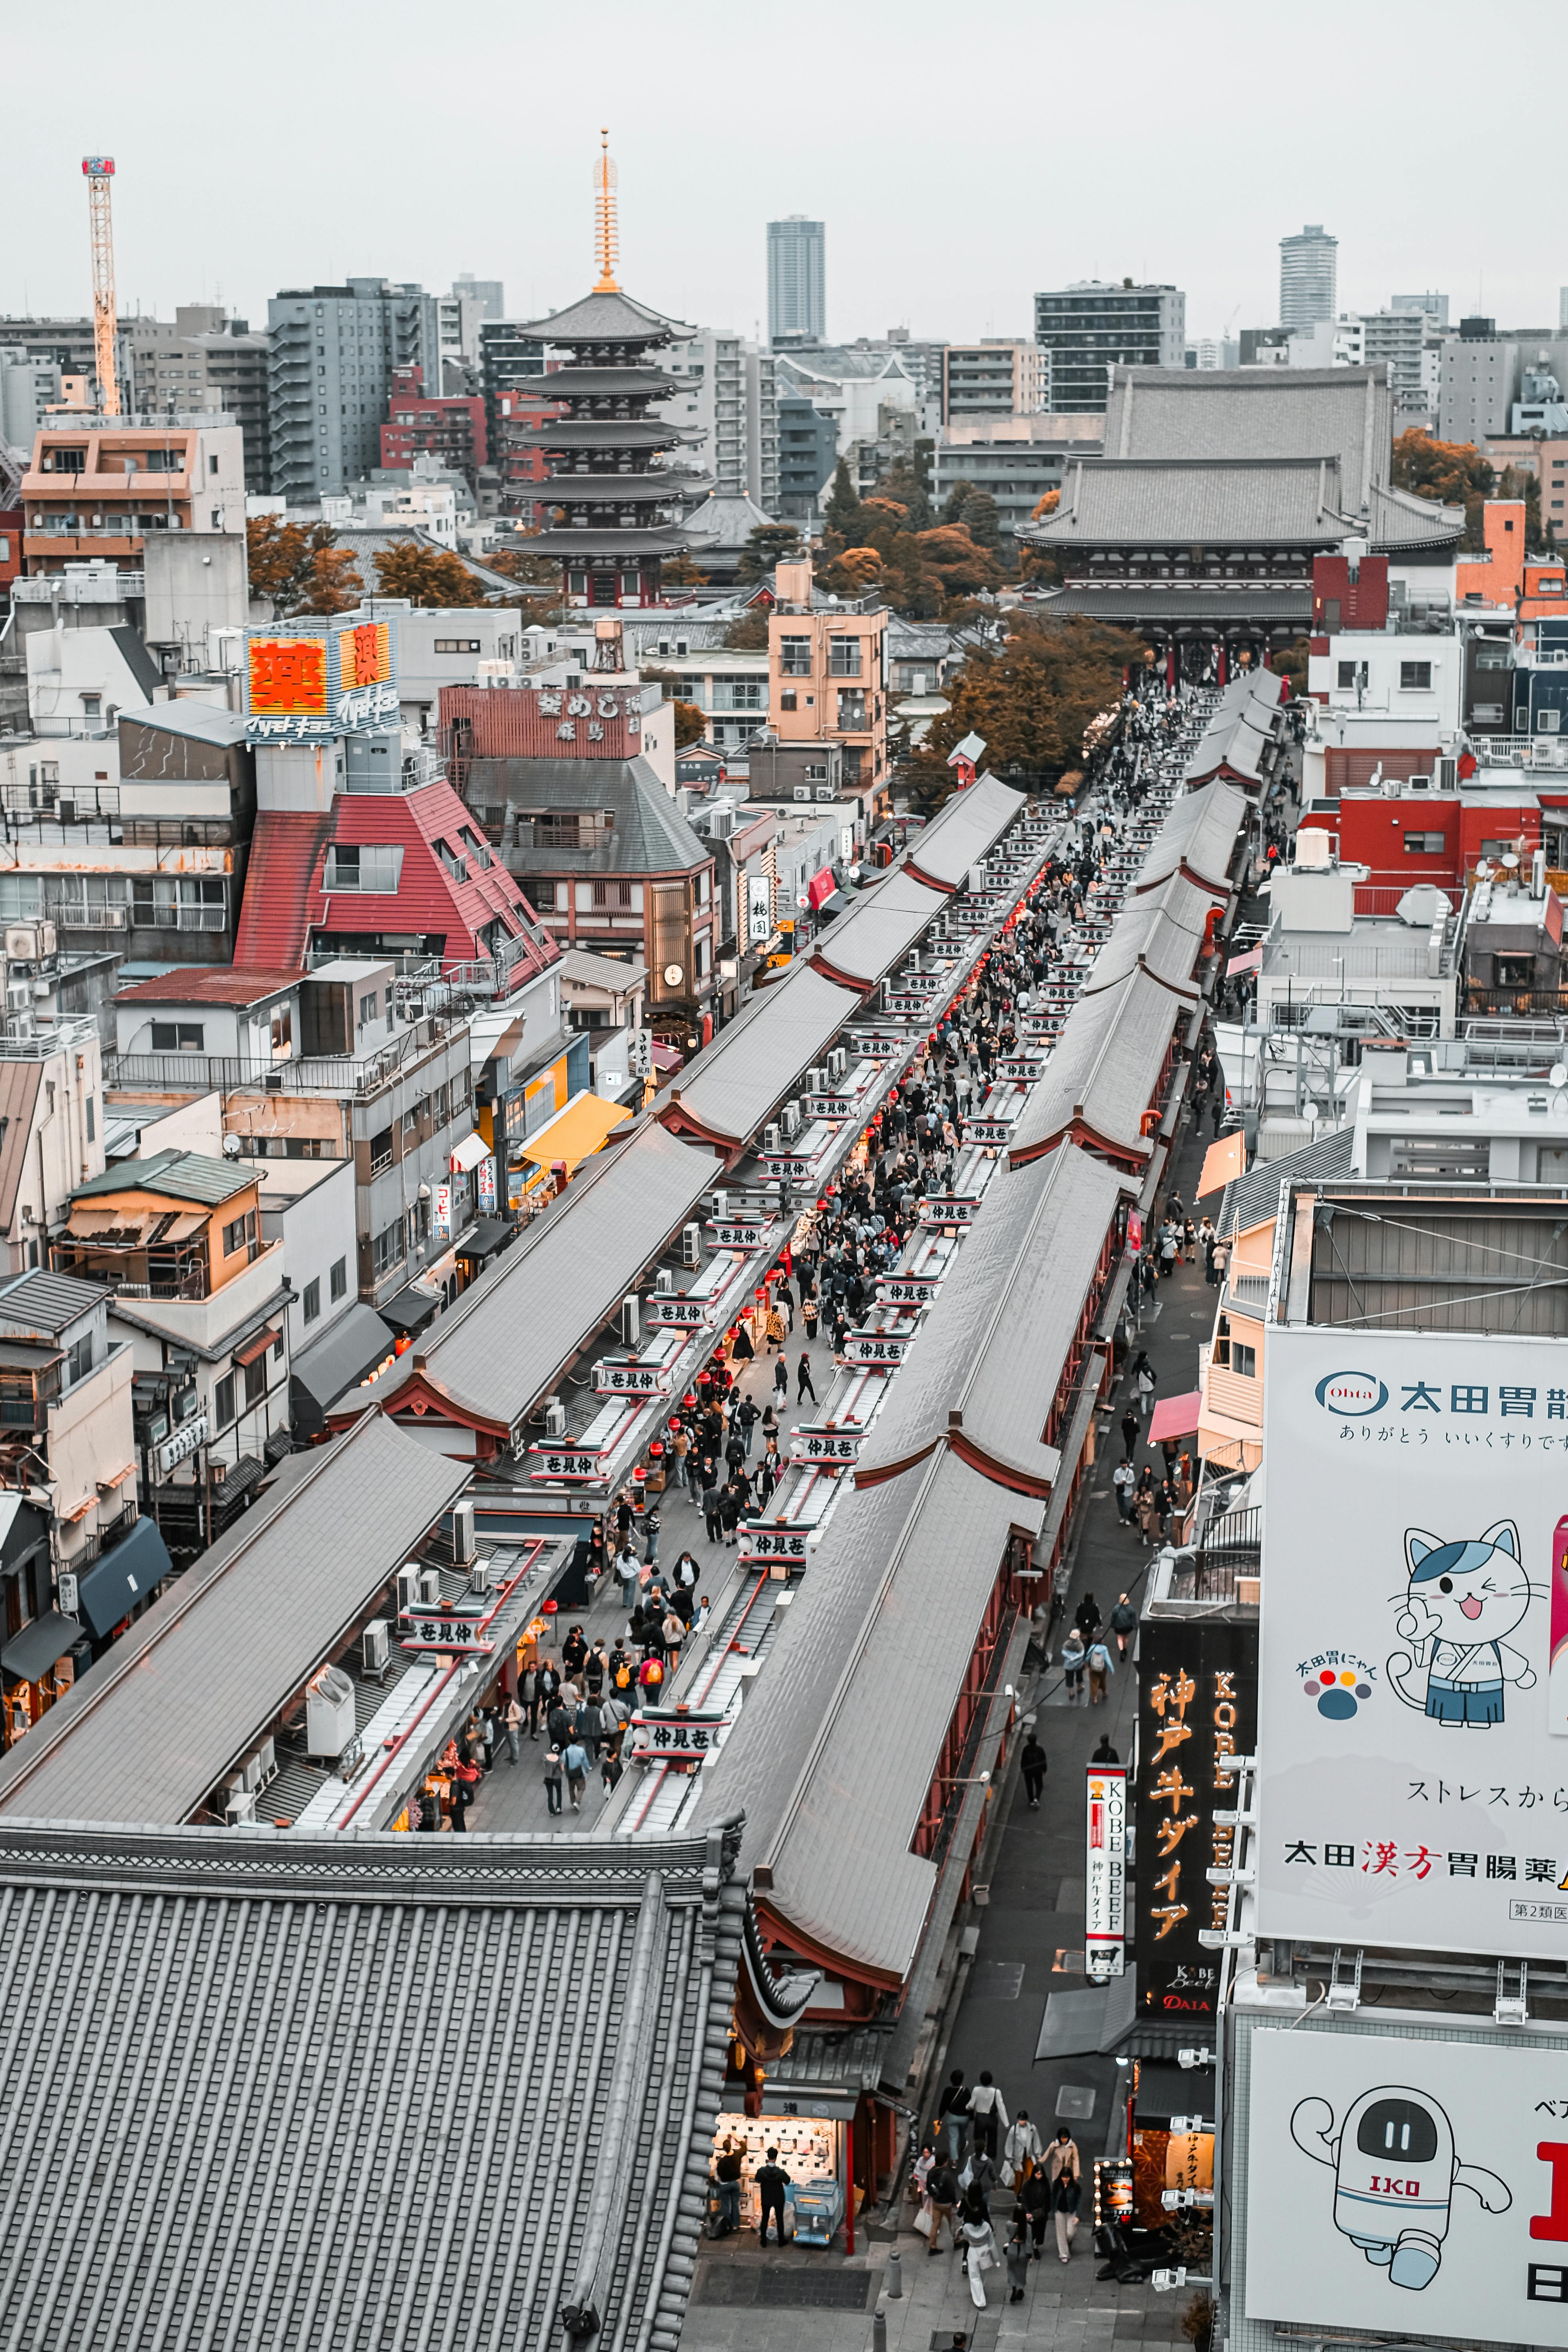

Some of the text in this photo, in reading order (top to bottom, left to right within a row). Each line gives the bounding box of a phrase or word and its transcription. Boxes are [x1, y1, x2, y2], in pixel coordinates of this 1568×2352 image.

[353, 623, 379, 685] 薬
[252, 643, 324, 709] 薬
[537, 692, 619, 718] 釜めし
[243, 715, 335, 738] マツモトキヨシ
[438, 1189, 448, 1221] コーヒー
[933, 1205, 967, 1219] 仲見世
[890, 1285, 929, 1300] 仲見世
[860, 1342, 900, 1359] 仲見世
[1330, 1387, 1372, 1399] Ohta
[1340, 1425, 1428, 1444] ありがとう
[808, 1439, 852, 1457] 仲見世
[756, 1537, 803, 1555] 仲見世
[1295, 1650, 1377, 1680] 太田胃にゃん
[654, 1727, 709, 1749] 仲見世
[1213, 1671, 1237, 1789] KOBE
[1149, 1667, 1198, 1940] 神戸牛ダイア
[1407, 1780, 1568, 1813] ストレスから
[1108, 1781, 1122, 1931] KOBE BEEF
[1092, 1861, 1104, 1930] 神戸牛ダイア
[1369, 2175, 1420, 2197] IKO
